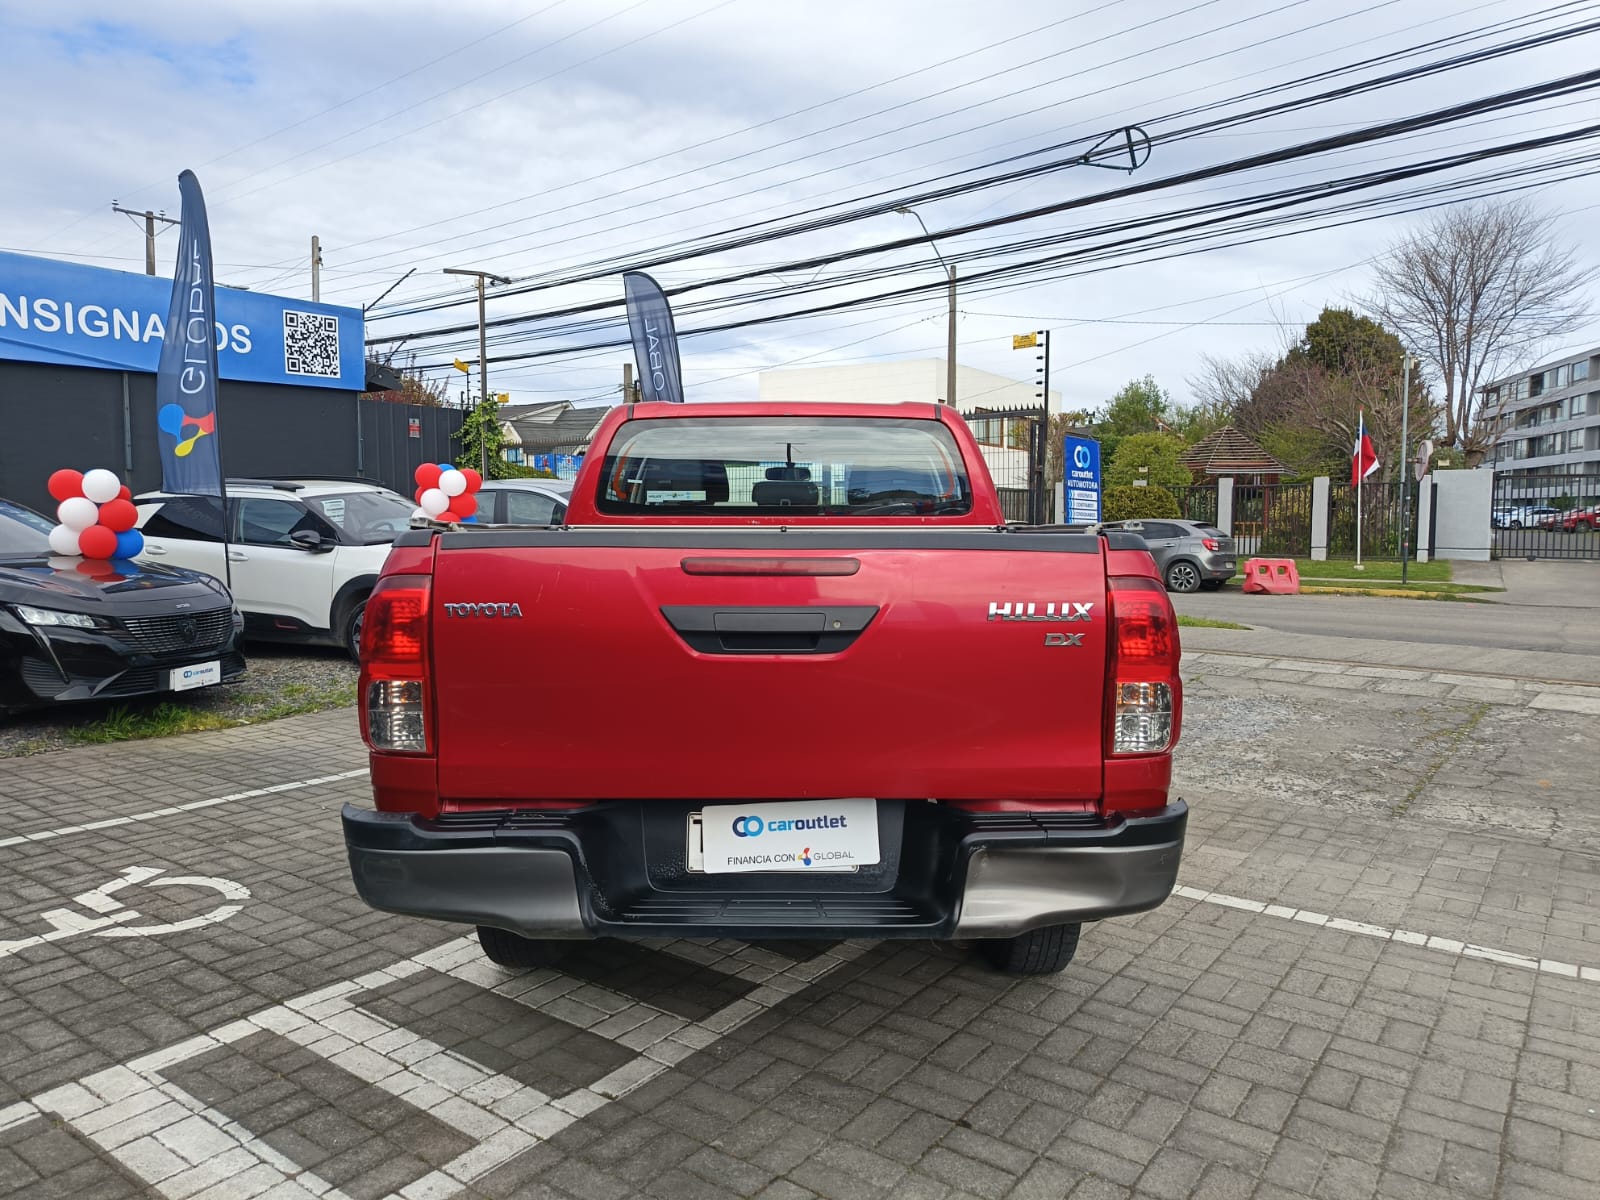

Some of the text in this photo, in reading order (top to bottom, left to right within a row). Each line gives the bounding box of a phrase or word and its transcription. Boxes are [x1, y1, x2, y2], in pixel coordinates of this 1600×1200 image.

[444, 603, 523, 618] TOYOTA
[987, 602, 1095, 622] HILUX
[1044, 632, 1086, 647] DX
[767, 815, 848, 832] caroutlet
[727, 850, 855, 866] FINANCIA CON GLOBAL
